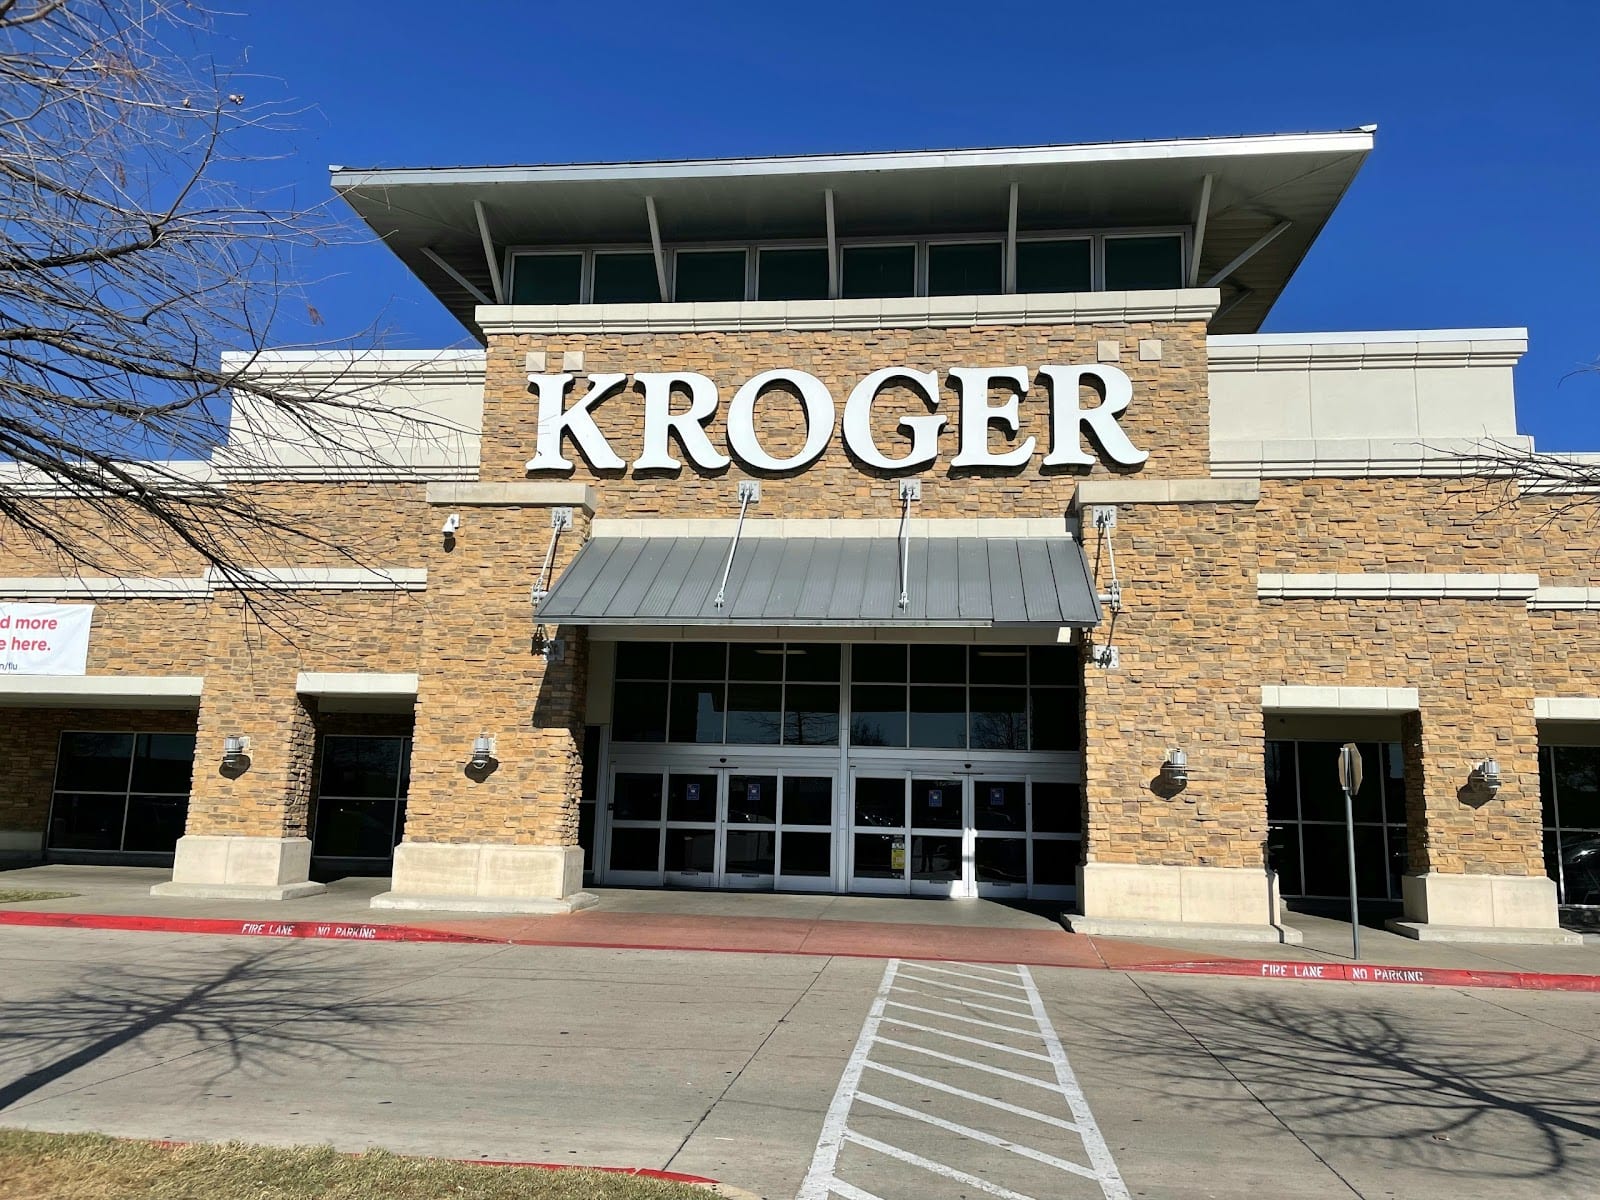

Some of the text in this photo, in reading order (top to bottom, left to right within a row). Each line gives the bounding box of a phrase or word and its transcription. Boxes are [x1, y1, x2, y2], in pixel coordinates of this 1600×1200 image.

[525, 364, 1150, 471] KROGER
[15, 618, 57, 629] more
[11, 636, 50, 650] here.
[241, 923, 295, 936] FIRE LANE
[317, 926, 376, 939] NO PARKING
[1262, 963, 1325, 978] FIRE LANE
[1352, 967, 1424, 983] NO PARKING
